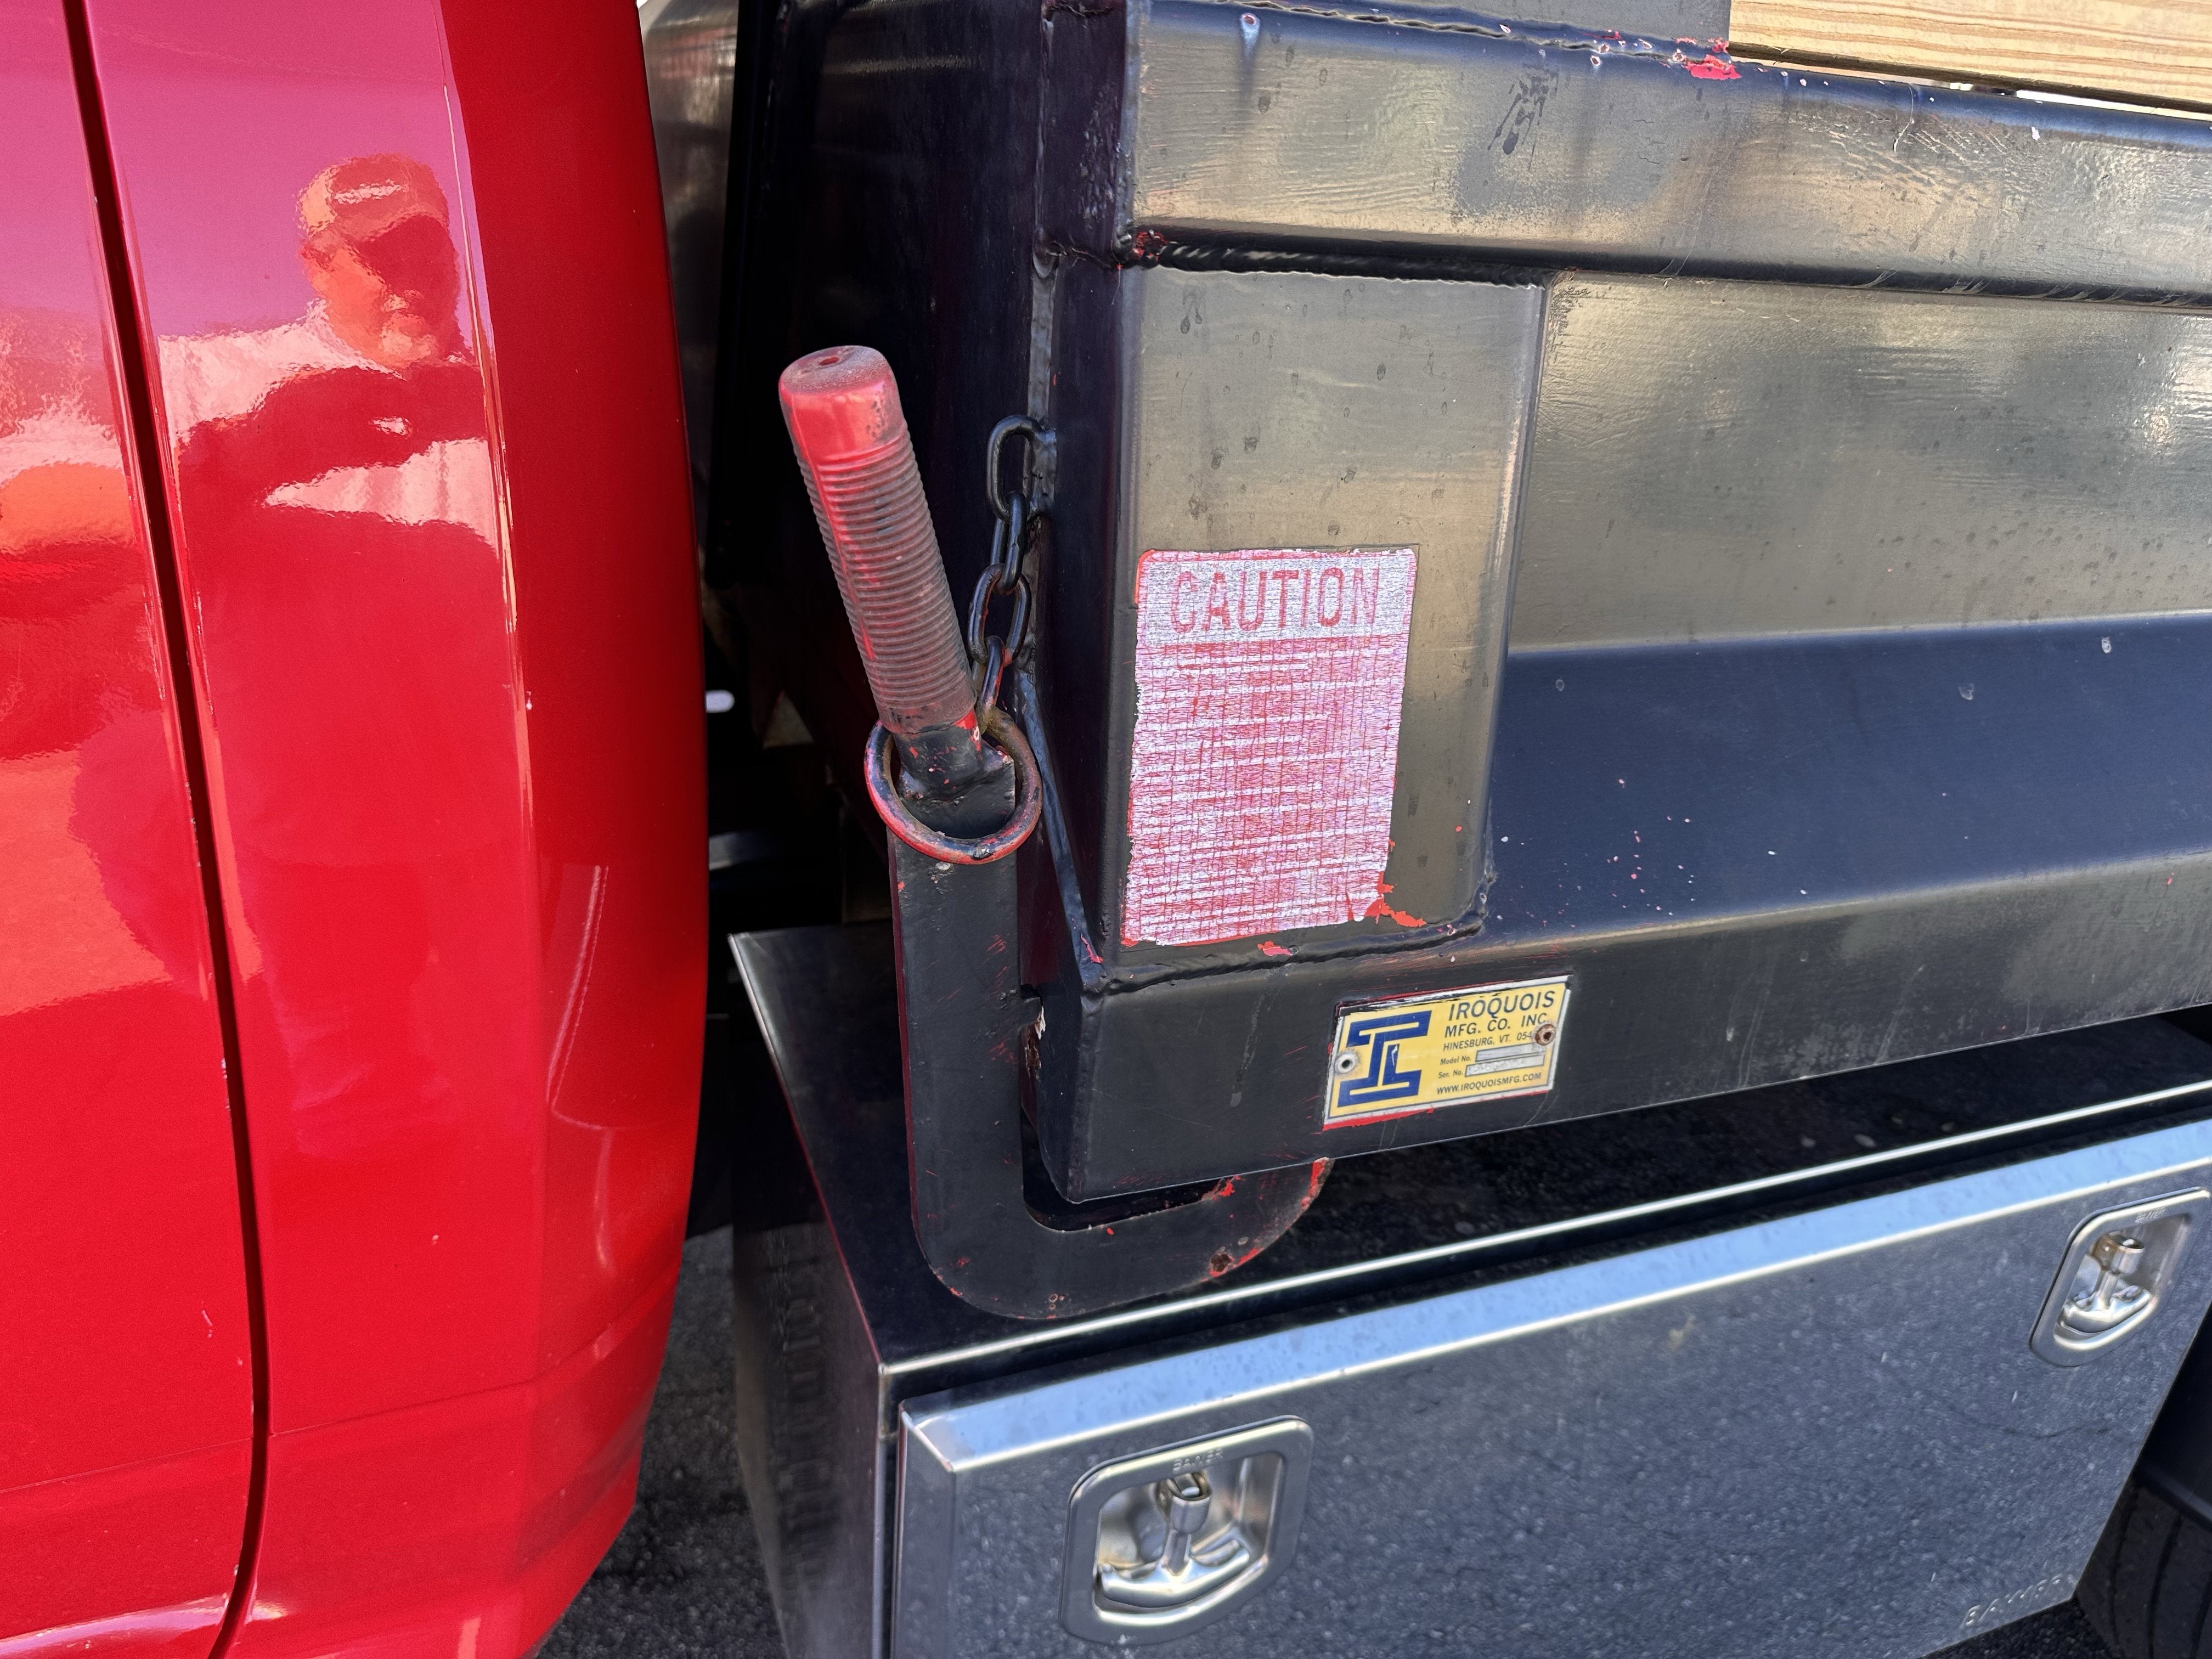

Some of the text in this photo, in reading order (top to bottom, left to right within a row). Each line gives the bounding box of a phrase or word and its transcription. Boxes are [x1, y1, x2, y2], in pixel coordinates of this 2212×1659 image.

[1170, 567, 1380, 633] CAUTION
[1448, 991, 1555, 1021] IROQUOIS
[1444, 1022, 1481, 1038] MFG.
[1487, 1018, 1511, 1031] CO.
[1440, 1057, 1459, 1065] Model
[1436, 1073, 1541, 1094] WWW.IROQUOISMFG.COM
